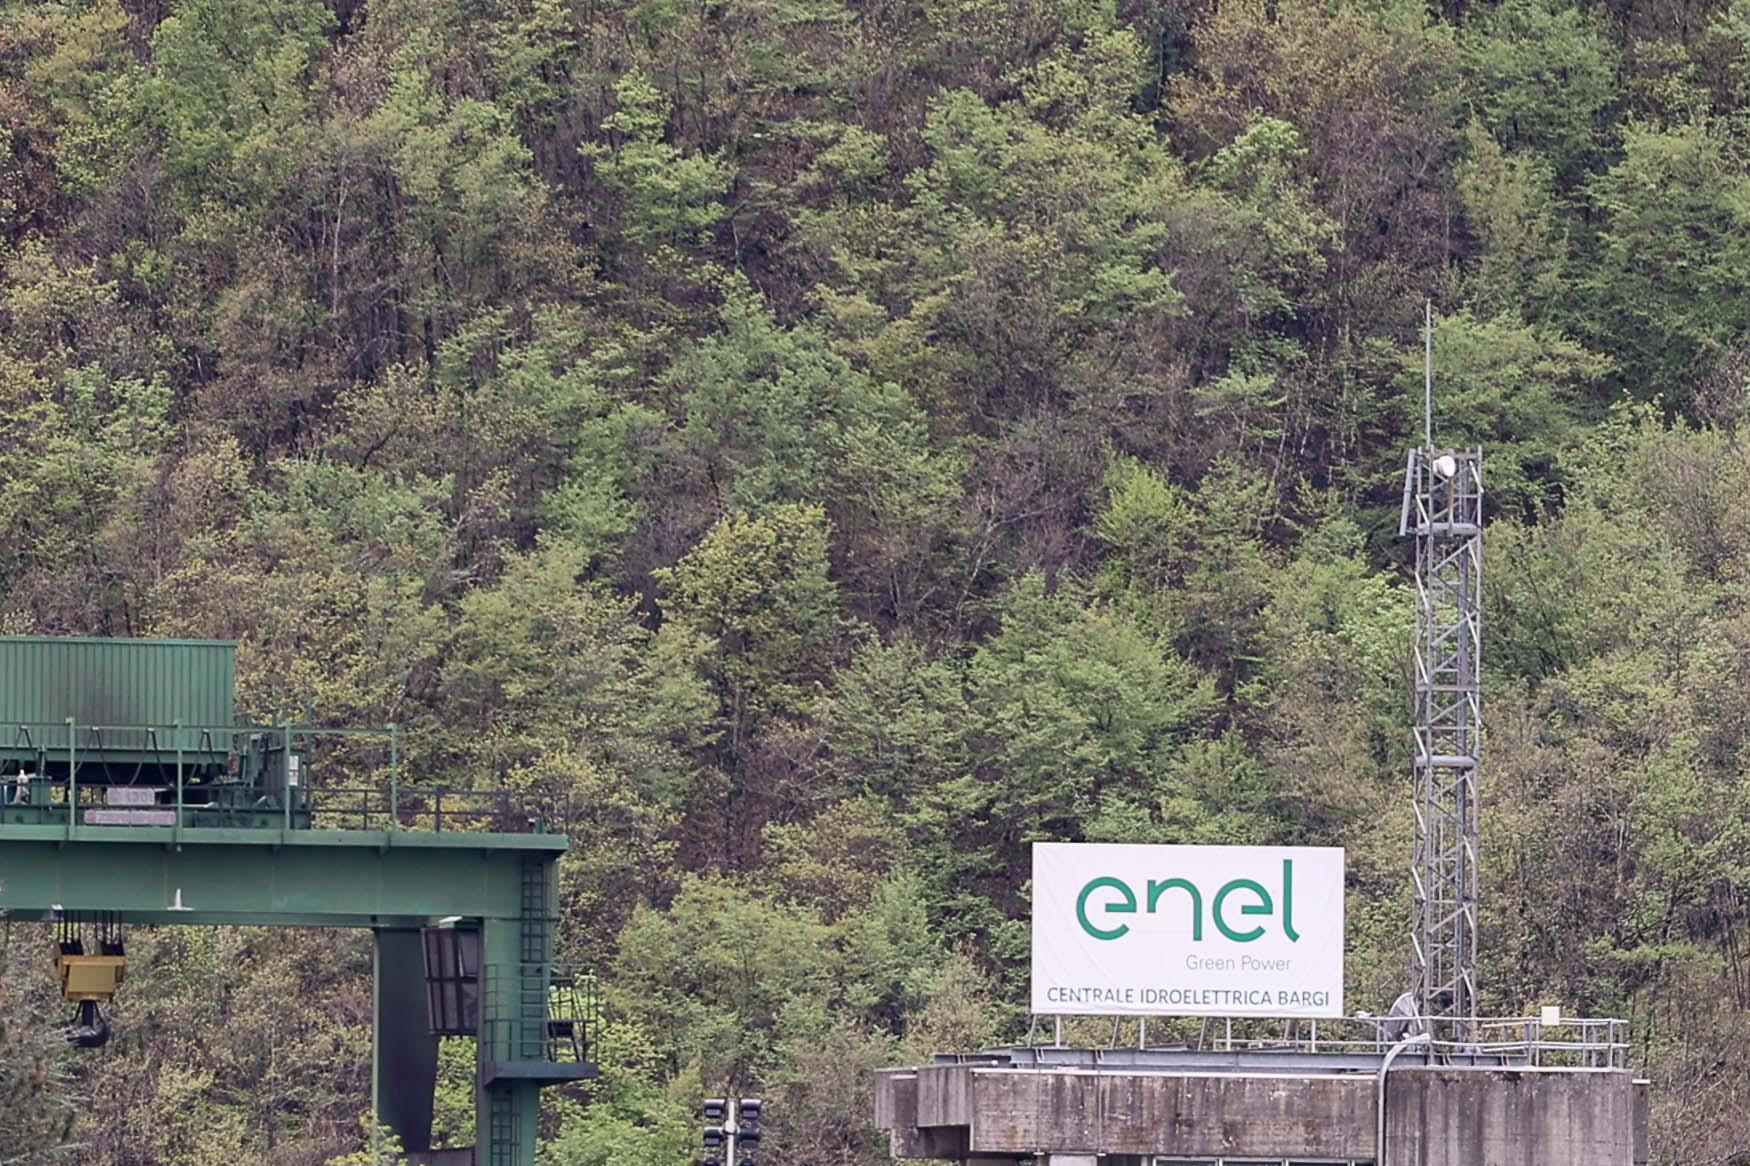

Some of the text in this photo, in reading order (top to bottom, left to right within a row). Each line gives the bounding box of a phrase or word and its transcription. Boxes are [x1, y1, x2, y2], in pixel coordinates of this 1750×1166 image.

[1076, 859, 1300, 942] enel
[1186, 954, 1291, 971] Green Power
[1047, 987, 1330, 1007] CENTRALE IDROELETTRICA BARGI
